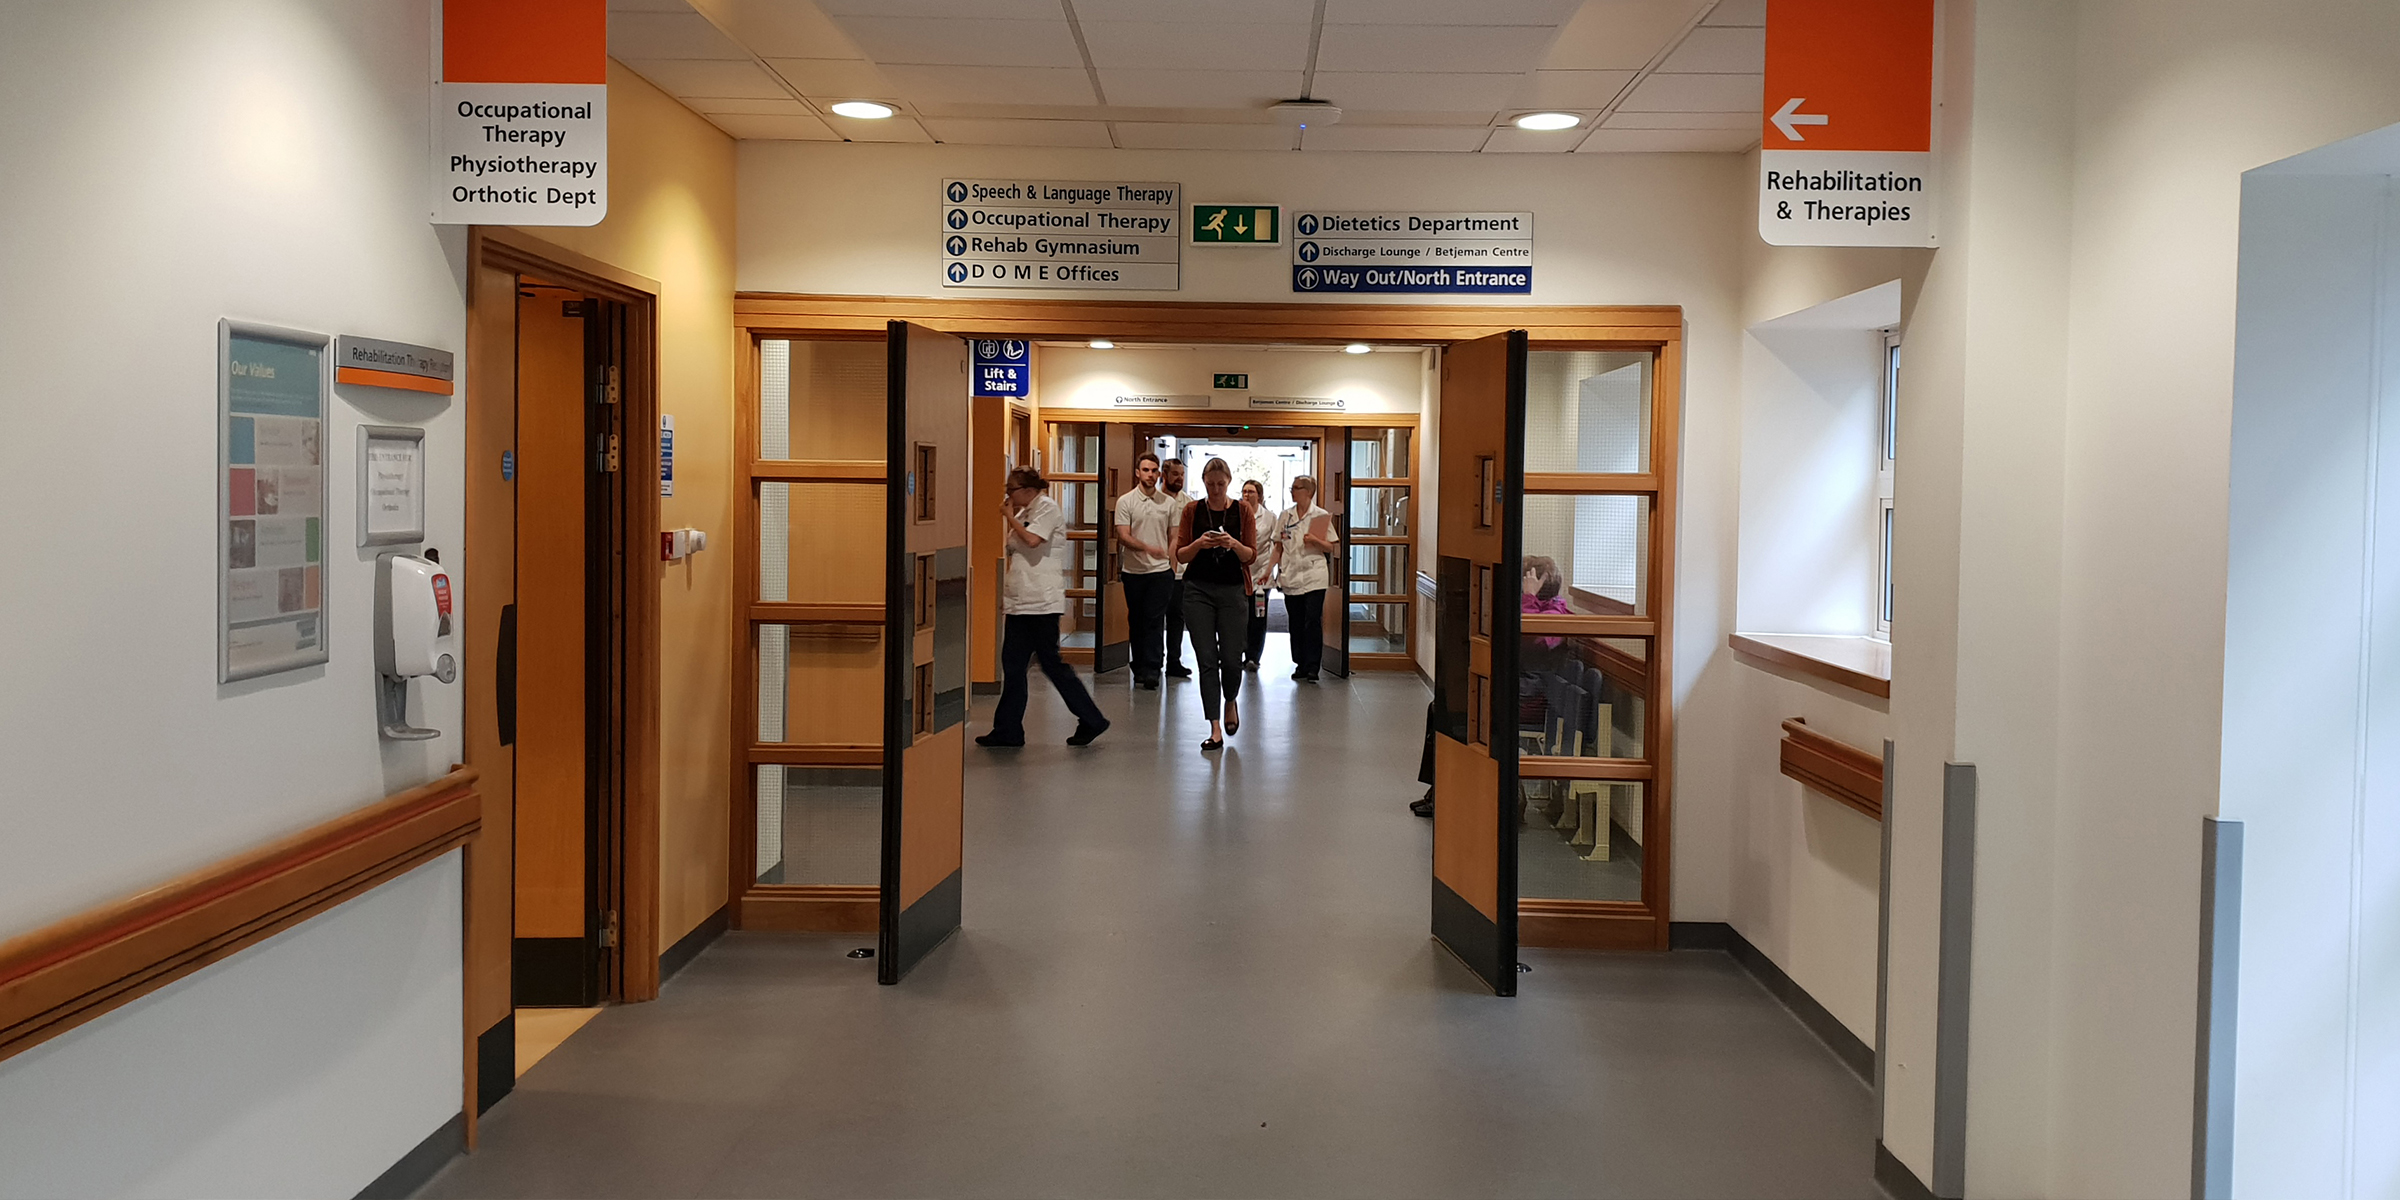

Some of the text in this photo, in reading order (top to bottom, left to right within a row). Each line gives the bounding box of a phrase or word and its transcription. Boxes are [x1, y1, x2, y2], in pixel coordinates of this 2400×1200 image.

[457, 100, 592, 123] Occupational
[482, 124, 566, 148] Therapy
[450, 154, 598, 179] Physiotherapy
[1767, 169, 1922, 192] Rehabilitation
[452, 185, 597, 209] Orthotic Dept
[971, 183, 1174, 205] Speech & Language Therapy
[972, 210, 1171, 233] Occupational Therapy
[1776, 199, 1911, 226] & Therapies
[1322, 215, 1520, 235] Dietetics Department
[971, 236, 1140, 257] Rehab Gymnasium
[1322, 246, 1530, 259] Discharge Lounge / Betjeman Centre
[972, 264, 1120, 282] D O M E Offices
[1322, 269, 1527, 289] Way Out/North Entrance
[231, 360, 276, 379] Our Values
[352, 346, 406, 367] Rehabilitation
[406, 353, 429, 373] Thapy
[984, 368, 1017, 379] Lift &
[984, 380, 1017, 391] Stairs
